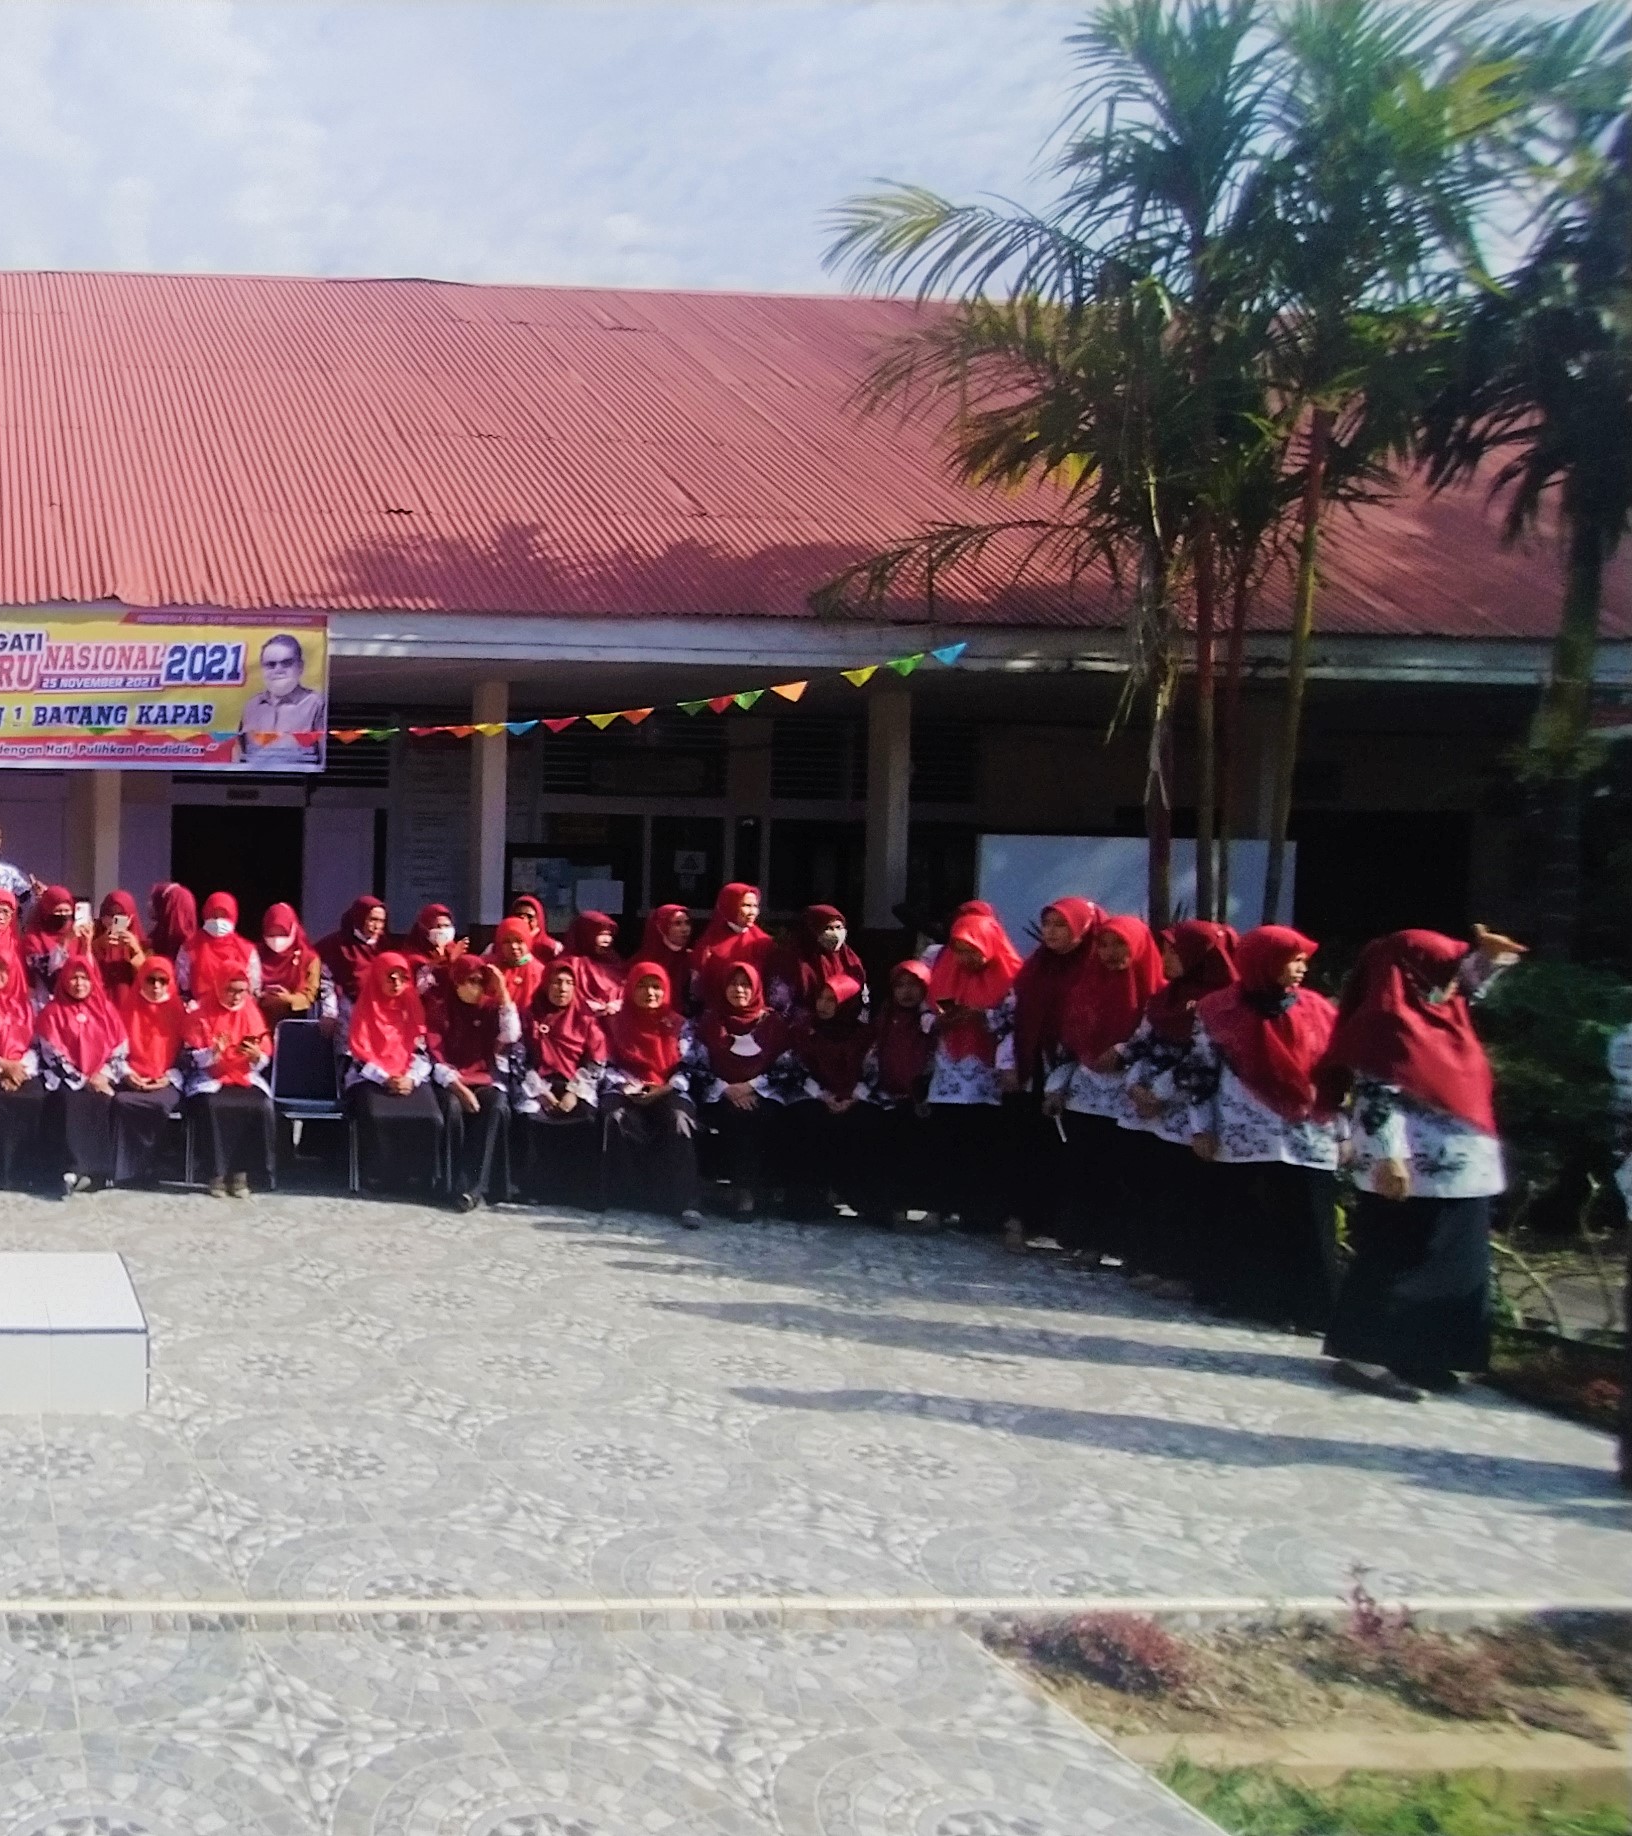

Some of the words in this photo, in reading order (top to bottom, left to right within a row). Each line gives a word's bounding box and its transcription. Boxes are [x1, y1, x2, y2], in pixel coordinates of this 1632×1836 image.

[44, 644, 164, 671] NASIONAL
[165, 644, 243, 683] 2021
[41, 677, 57, 689] 25
[59, 676, 126, 688] NOVEMBER
[126, 675, 155, 687] 2021
[12, 706, 23, 727] 1
[32, 704, 128, 726] BATANG
[134, 703, 214, 725] KAPAS
[46, 744, 74, 756] Hati,
[79, 744, 134, 755] Pulihkan
